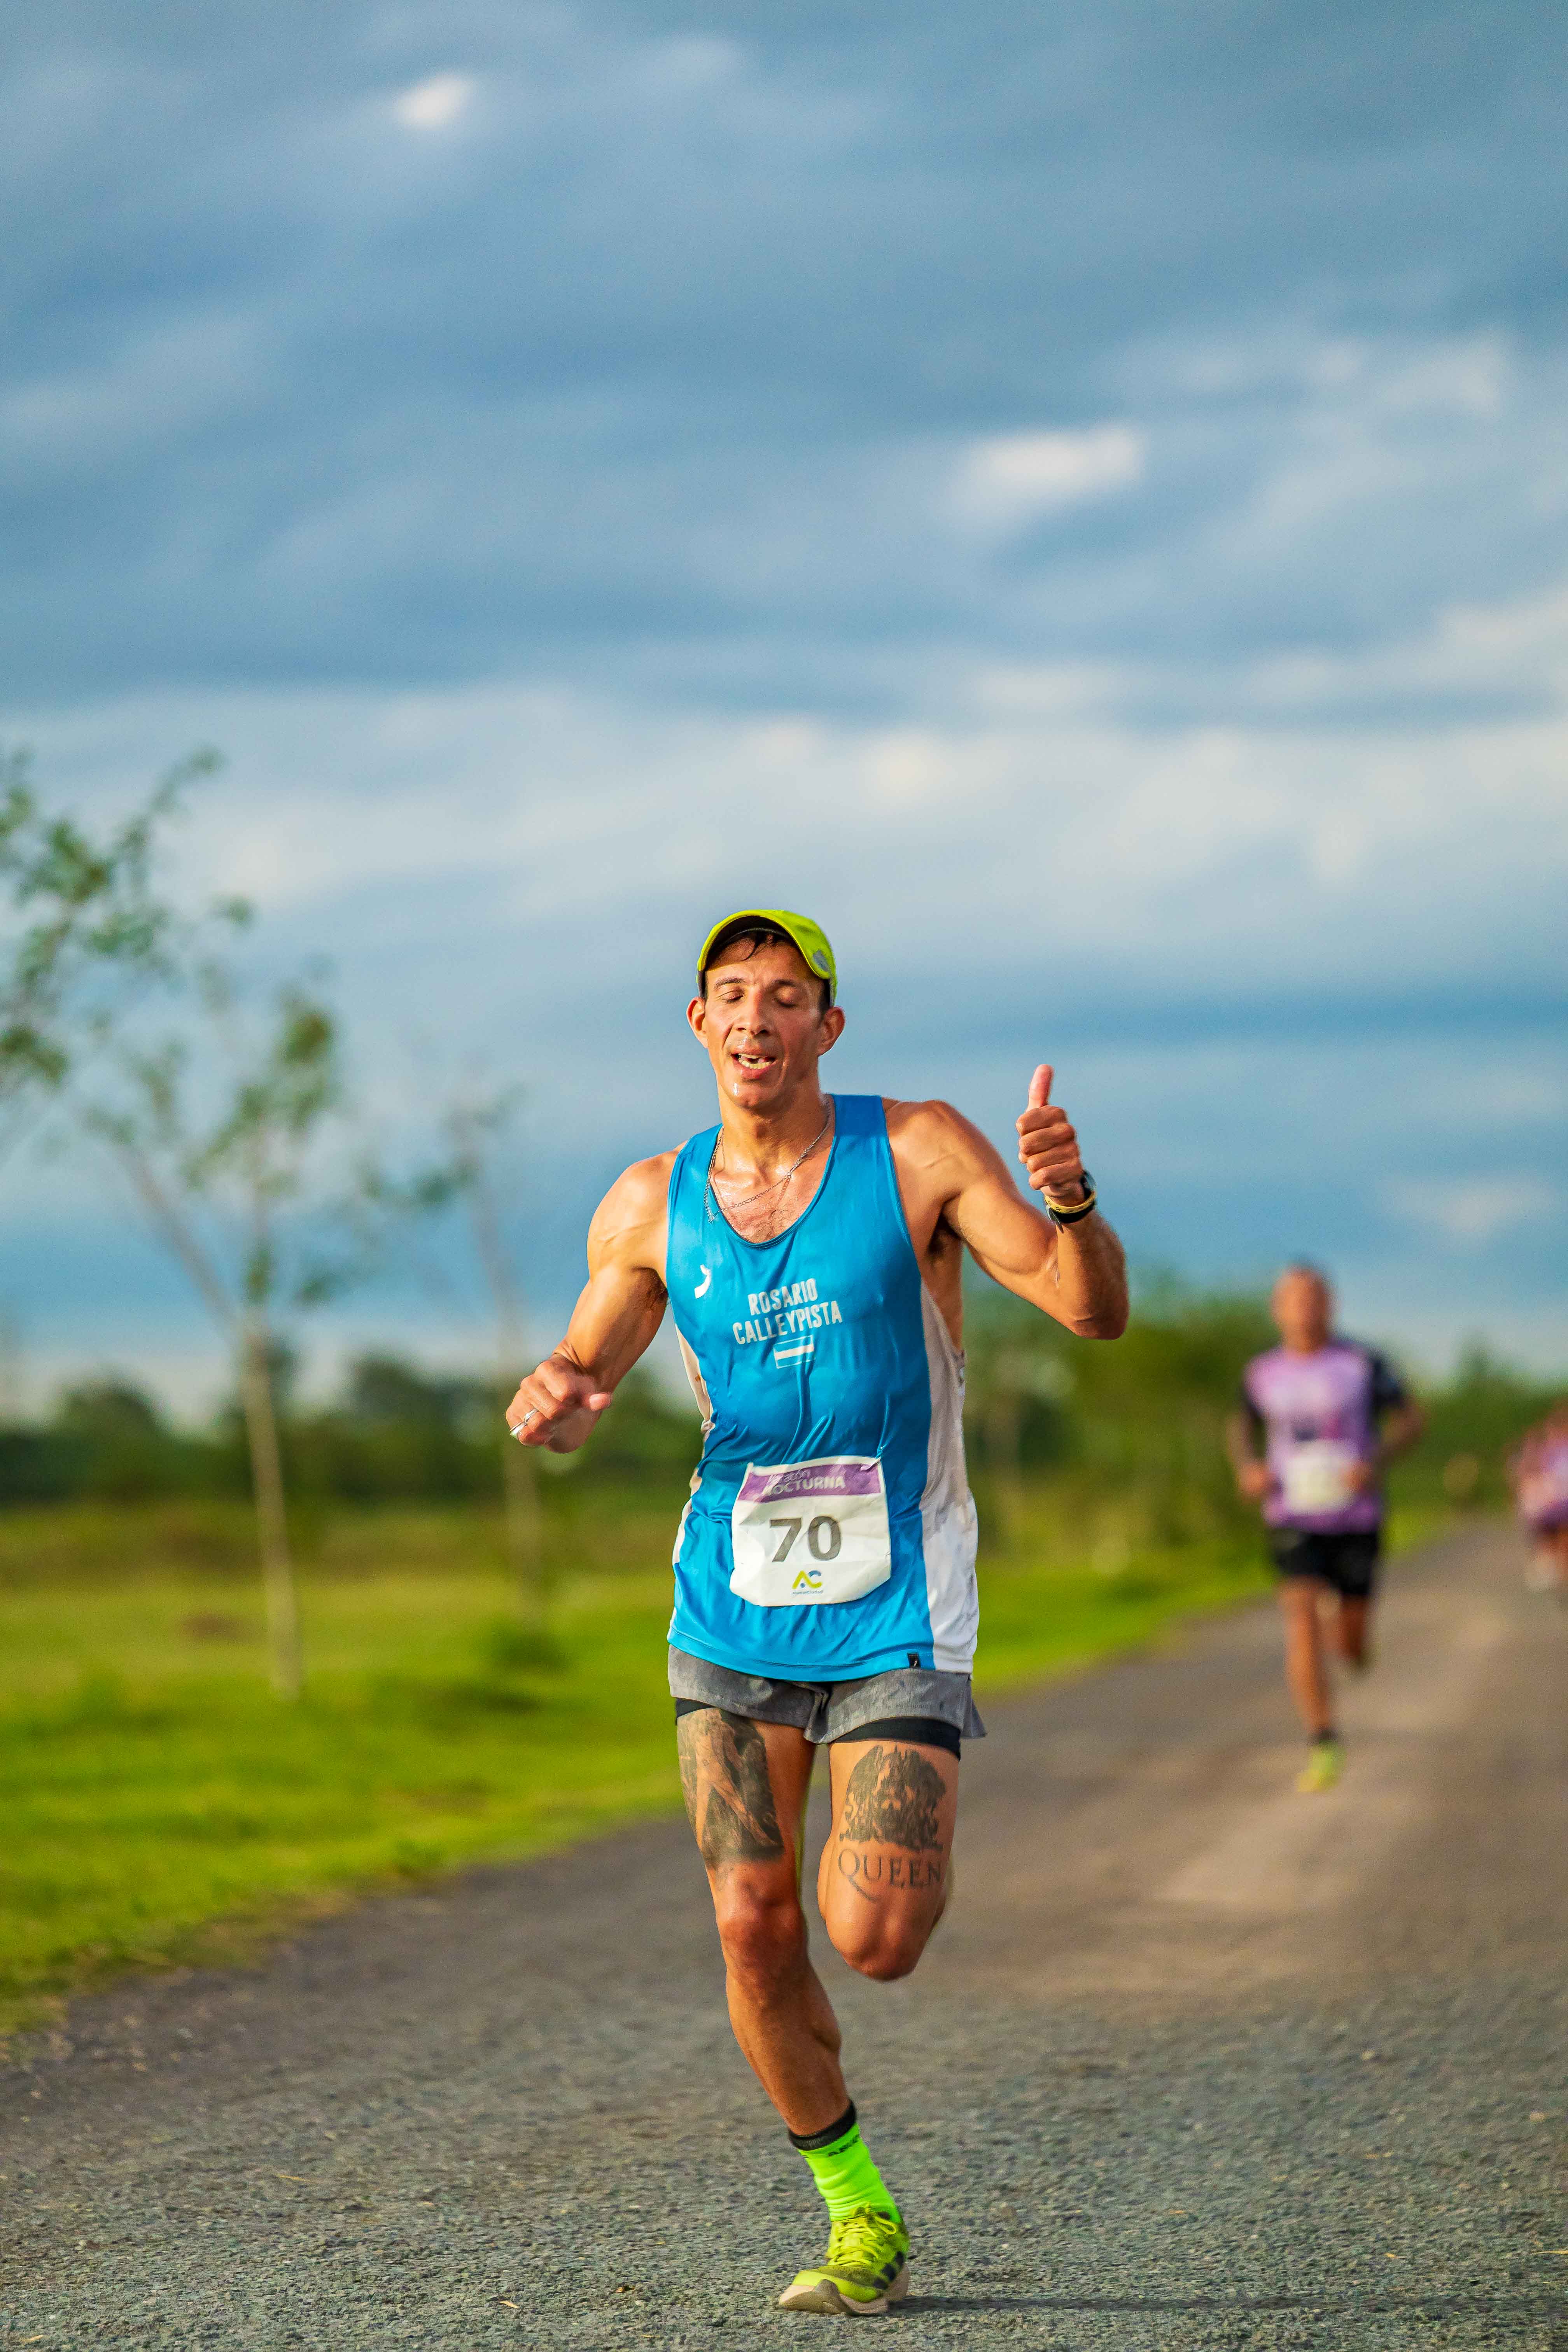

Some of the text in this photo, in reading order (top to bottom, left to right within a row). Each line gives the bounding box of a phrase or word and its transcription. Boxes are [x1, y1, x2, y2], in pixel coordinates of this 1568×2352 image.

[747, 1278, 818, 1316] ROSARIO
[732, 1300, 843, 1344] CALLEYPISTA
[770, 1516, 841, 1563] 70
[838, 1848, 942, 1901] QUEEN
